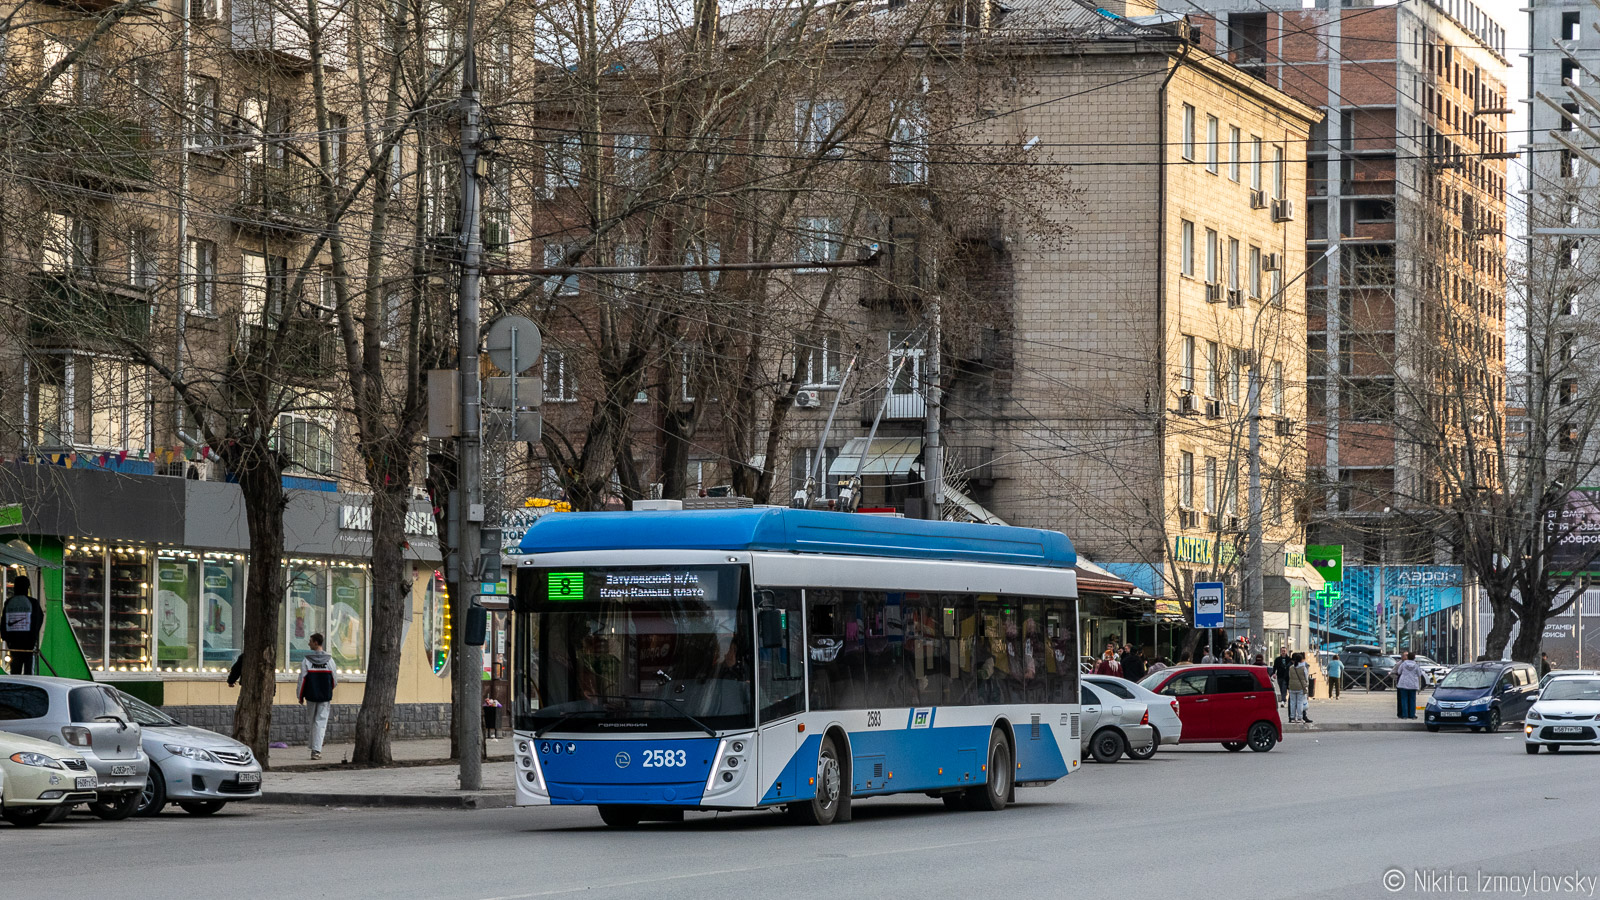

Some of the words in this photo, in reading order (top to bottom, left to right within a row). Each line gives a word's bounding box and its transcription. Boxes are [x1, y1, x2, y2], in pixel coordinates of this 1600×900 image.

[343, 505, 438, 536] КАНАРЫ
[1176, 536, 1212, 564] АПТЕКА
[560, 577, 571, 596] 8
[606, 573, 671, 586] Затулинский
[673, 571, 699, 586] ж/м
[673, 588, 705, 598] плато
[867, 710, 881, 728] 2583
[642, 749, 687, 767] 2583
